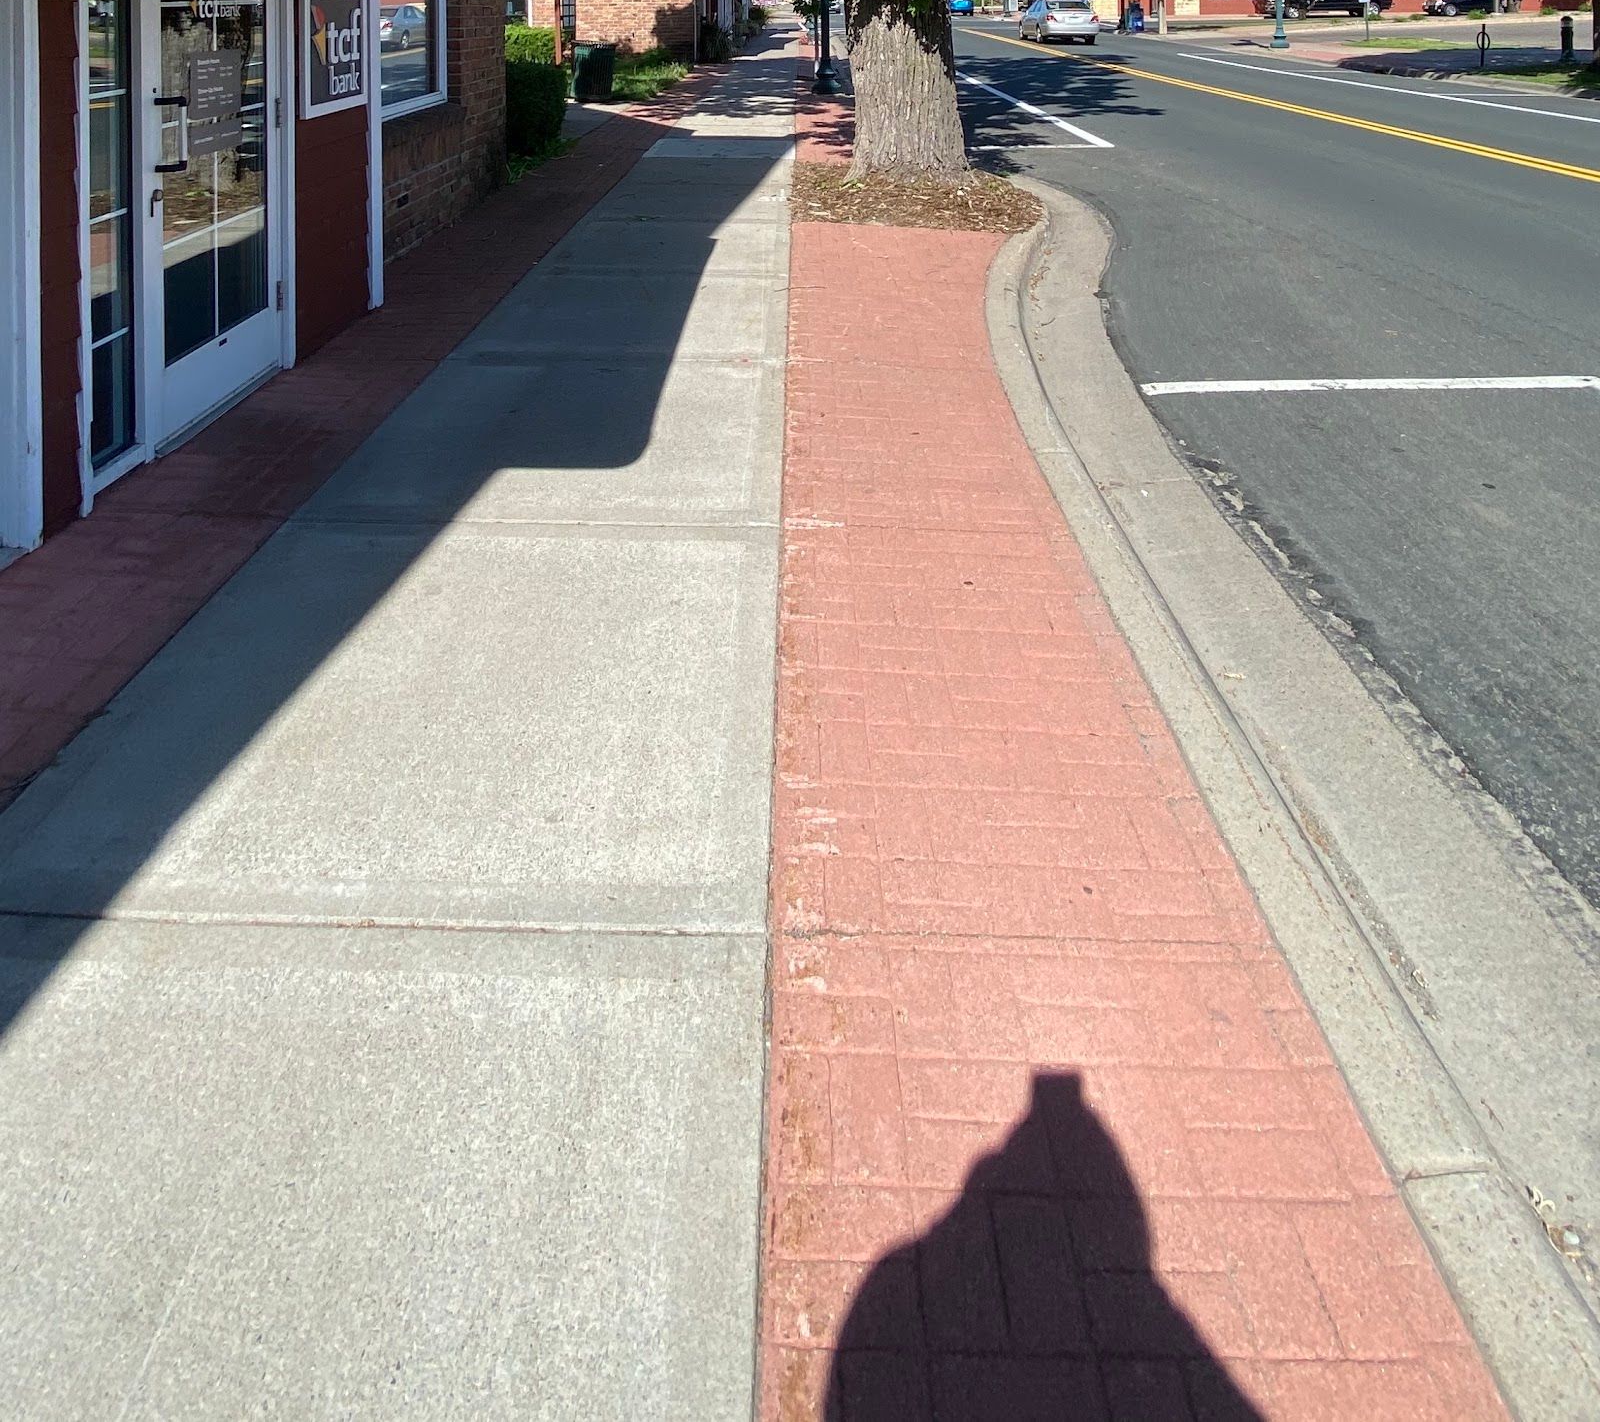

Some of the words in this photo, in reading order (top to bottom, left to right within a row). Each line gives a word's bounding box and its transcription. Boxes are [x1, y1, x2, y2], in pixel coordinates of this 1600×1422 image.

[220, 4, 241, 18] bank
[327, 7, 360, 64] tcf
[328, 62, 360, 95] bank
